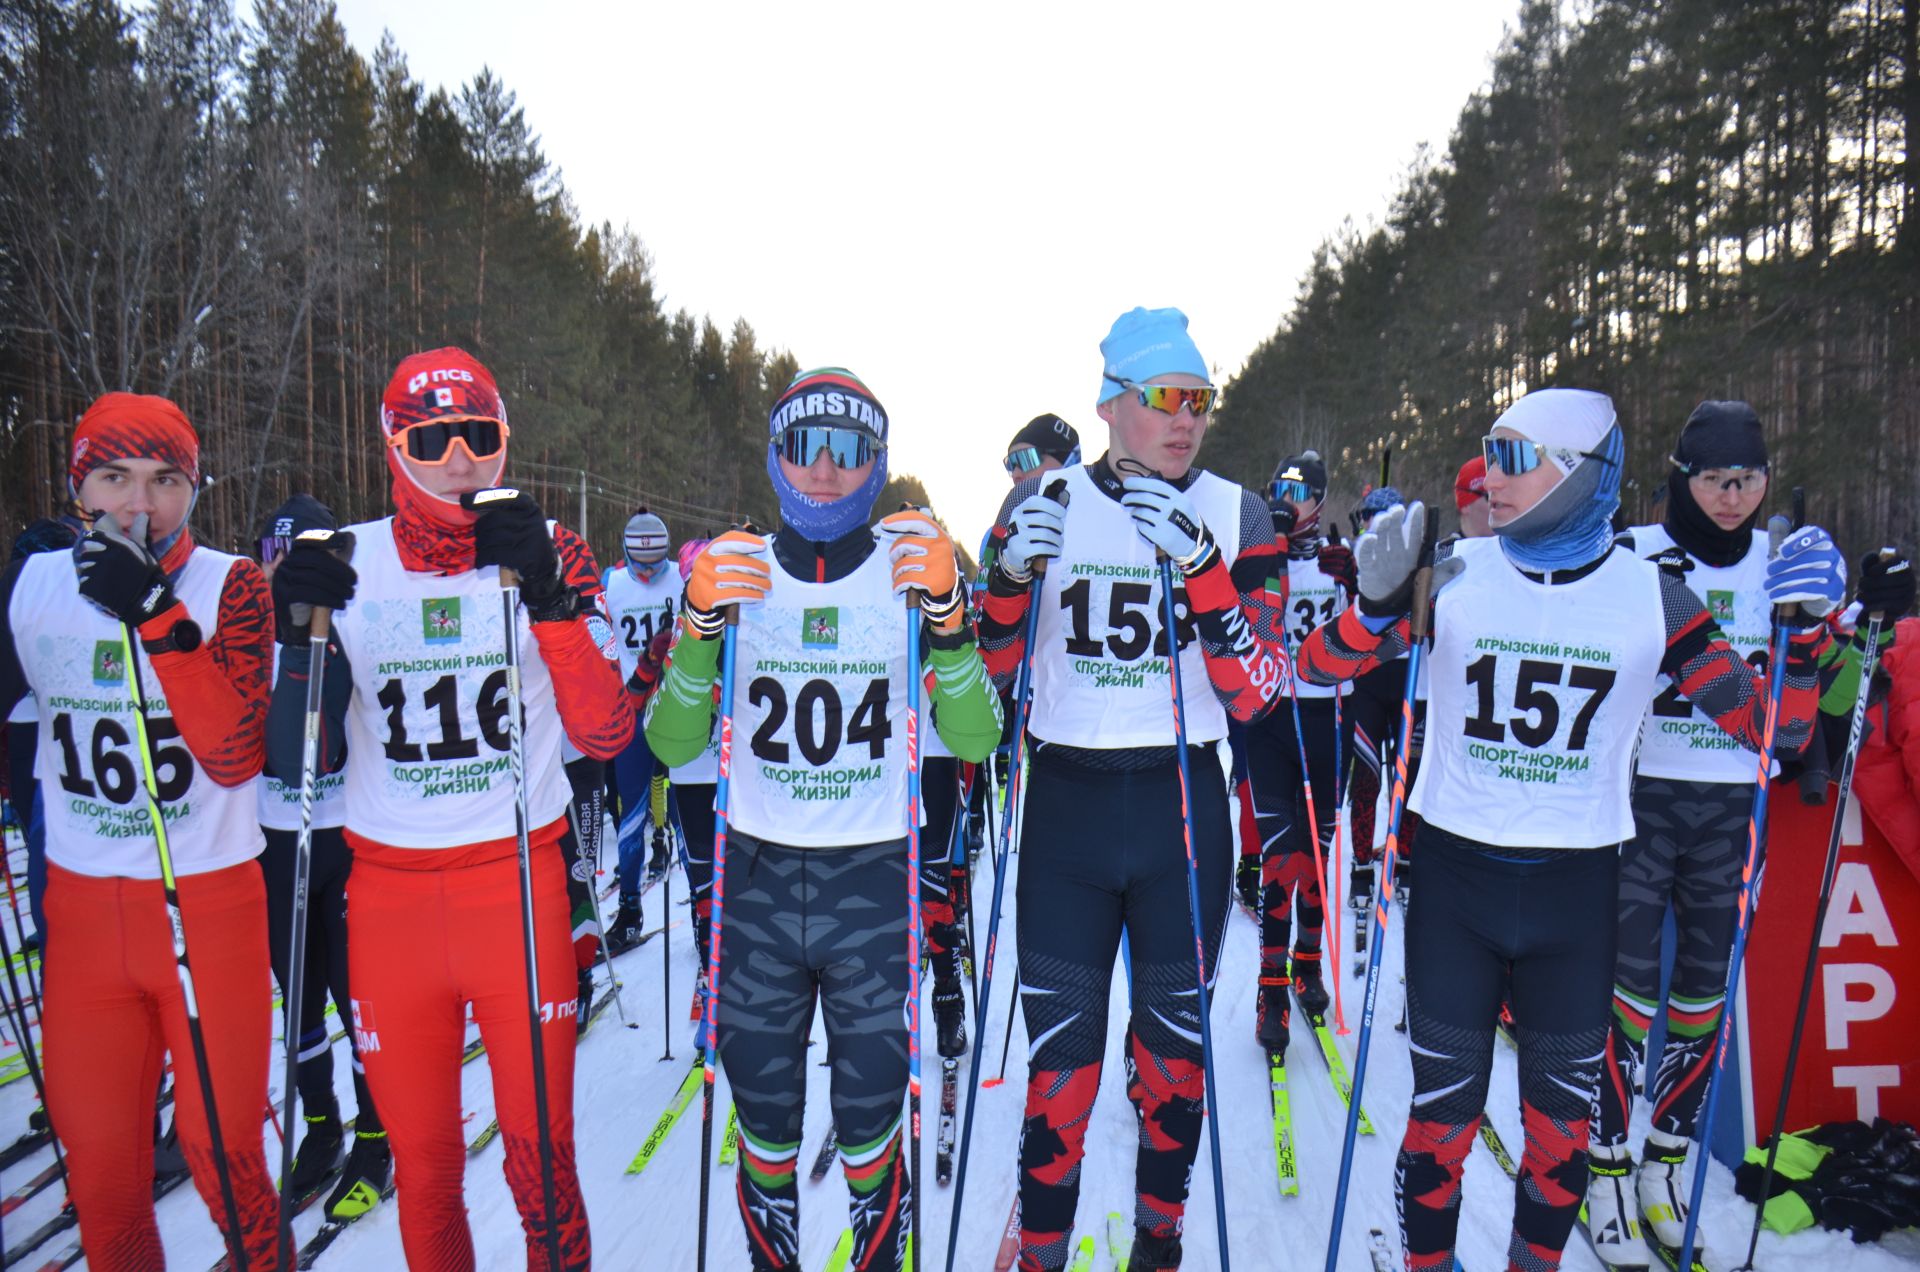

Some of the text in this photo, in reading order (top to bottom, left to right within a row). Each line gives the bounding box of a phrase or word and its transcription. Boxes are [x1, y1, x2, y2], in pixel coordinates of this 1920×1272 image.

[432, 368, 474, 383] ПСБ
[773, 391, 884, 438] ATARSTAN
[1070, 563, 1151, 580] АГРЫЗСКИЙ
[378, 650, 508, 675] АГРЫЗСКИЙ РАЙО
[1474, 637, 1611, 663] АГРЫЗСКИЙ РАЙОН
[756, 659, 887, 674] АГРЫЗСКИЙ РАЙОН
[49, 696, 169, 712] АГРЫЗСКИЙ РЙО
[1463, 654, 1617, 751] 157
[376, 668, 527, 763] 116
[748, 676, 892, 766] 204
[1661, 721, 1707, 735] СПОРТ
[53, 711, 194, 805] 165
[393, 755, 512, 782] СПОРТ НОРМ
[1468, 743, 1590, 771] СПОРТ НОРМА
[763, 764, 882, 785] СПОРТ НОРМА
[1498, 764, 1558, 784] ЖИЗНИ
[422, 775, 491, 799] ЖИЗНИ
[791, 784, 852, 801] ЖИЗНИ
[72, 798, 190, 824] СПОРТ НОМА
[640, 1112, 674, 1158] FISCHER
